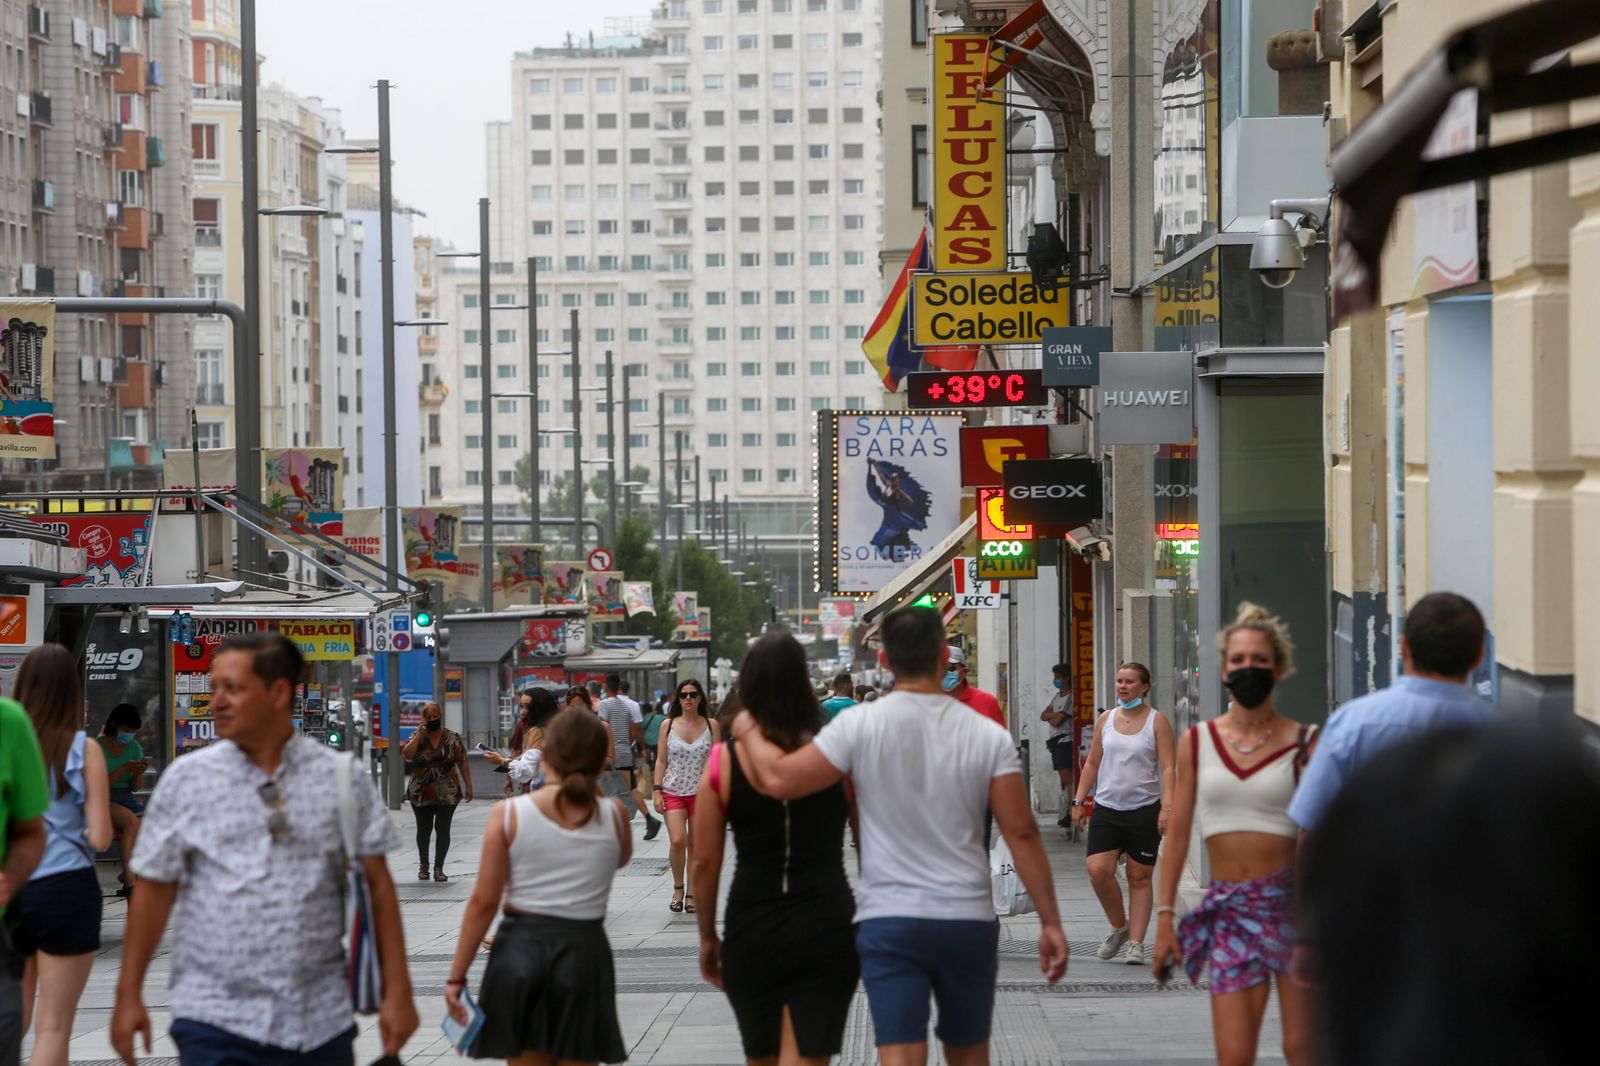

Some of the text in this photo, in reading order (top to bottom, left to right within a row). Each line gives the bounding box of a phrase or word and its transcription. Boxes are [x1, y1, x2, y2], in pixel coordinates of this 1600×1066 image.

[943, 38, 996, 264] PELUCAS
[924, 278, 1059, 306] Soledad
[930, 312, 1054, 340] Cabello
[1048, 344, 1082, 354] GRAN
[1103, 390, 1189, 407] HUAWEI
[856, 416, 937, 436] SARA
[846, 438, 948, 457] BARAS
[1009, 485, 1087, 499] GEOX
[841, 545, 934, 561] SOMBR
[981, 558, 1033, 571] ATM
[962, 596, 994, 606] KFC
[281, 624, 351, 636] TABACO
[323, 639, 351, 653] FRÍA
[89, 673, 117, 681] CINES
